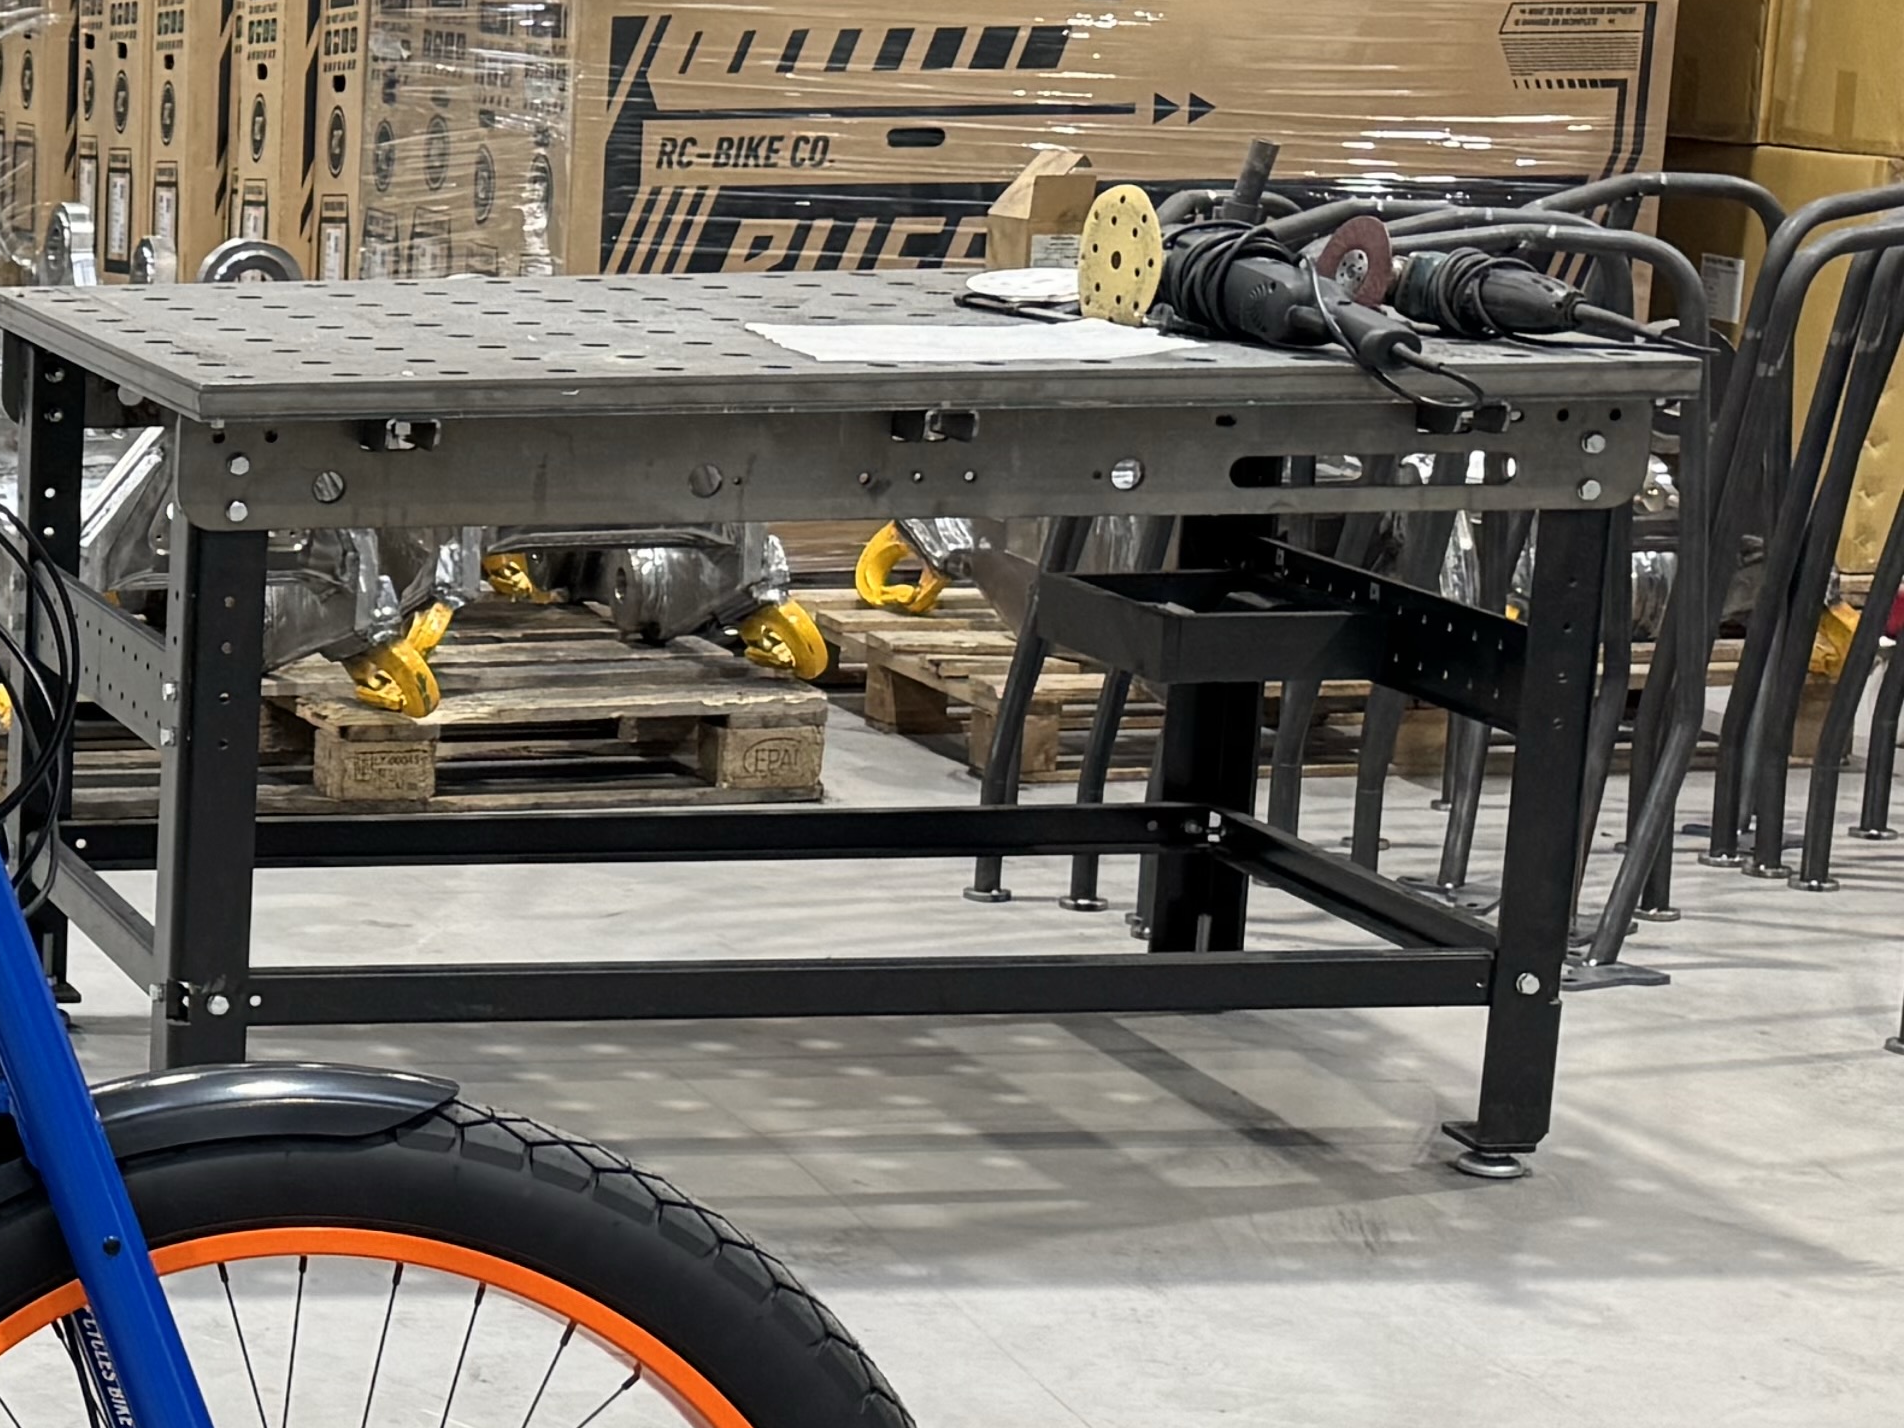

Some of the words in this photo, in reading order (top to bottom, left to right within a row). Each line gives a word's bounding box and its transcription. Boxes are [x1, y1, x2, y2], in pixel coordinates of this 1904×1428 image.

[656, 135, 784, 170] RC-BIKE
[790, 135, 836, 168] CO.
[107, 1385, 134, 1427] BIKE
